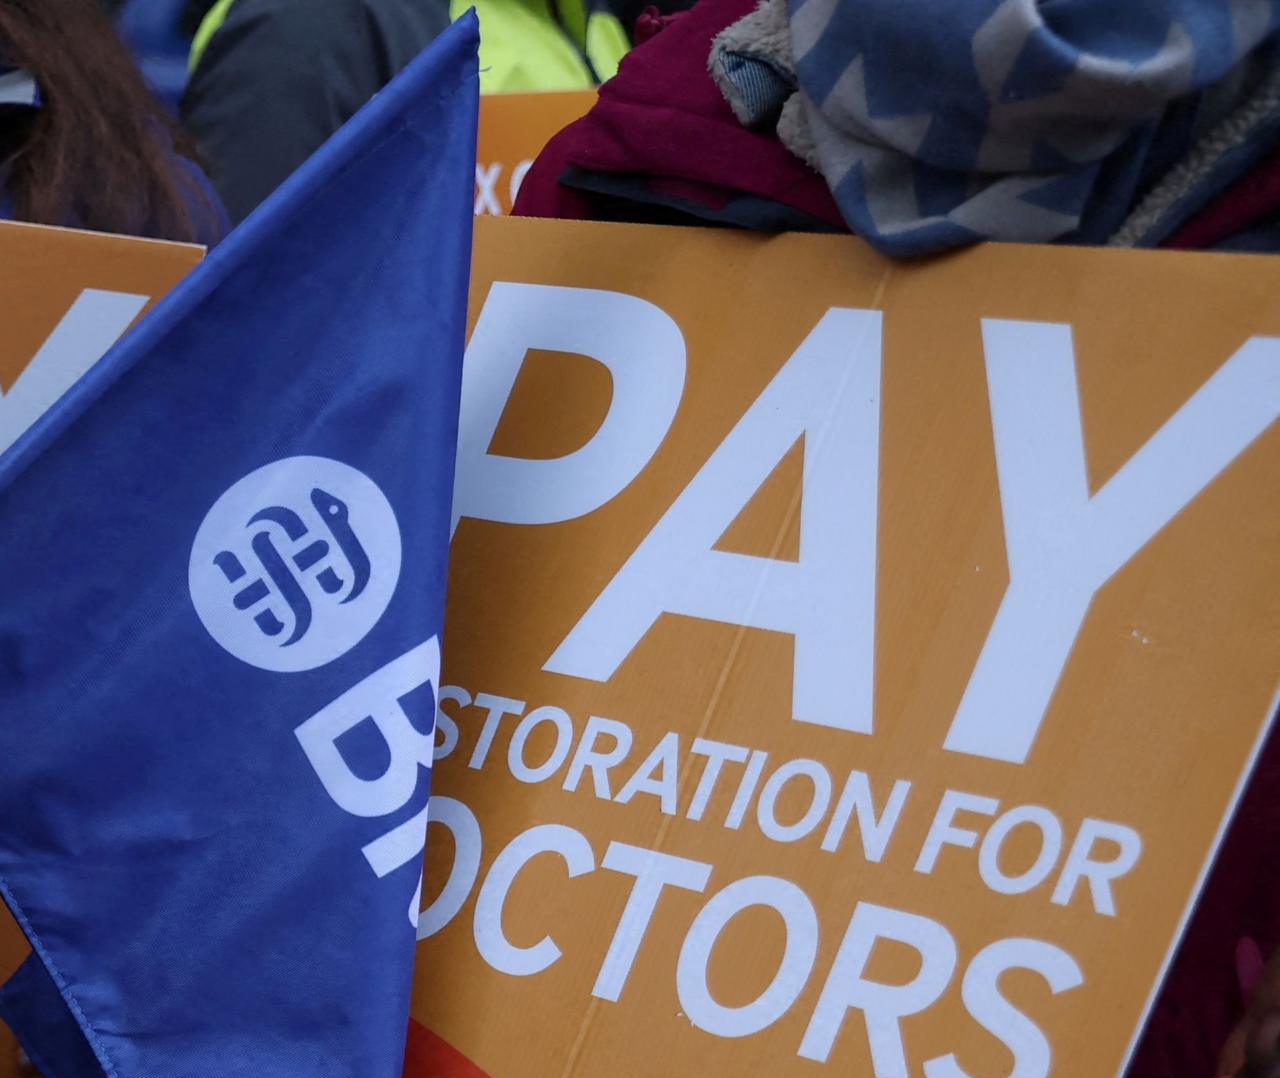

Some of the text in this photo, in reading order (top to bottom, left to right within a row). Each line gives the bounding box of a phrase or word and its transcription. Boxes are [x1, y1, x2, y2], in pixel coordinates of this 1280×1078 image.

[448, 280, 1280, 765] PAY
[432, 684, 912, 864] STORATION
[913, 789, 1142, 917] FOR
